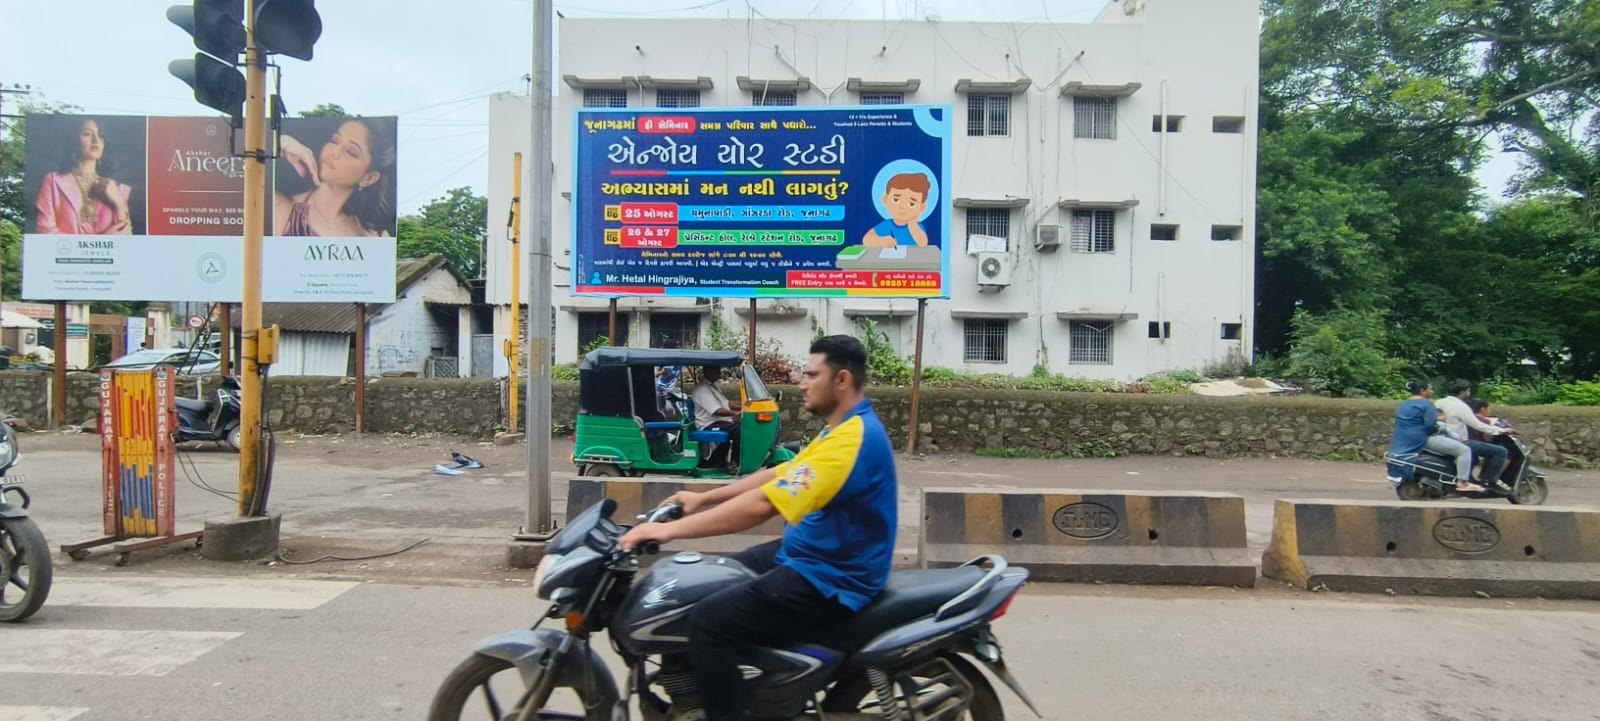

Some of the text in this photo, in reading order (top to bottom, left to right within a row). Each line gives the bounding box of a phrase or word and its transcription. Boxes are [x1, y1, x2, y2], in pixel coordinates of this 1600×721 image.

[607, 134, 845, 169] એન્જોય યોર સ્ટડી
[601, 178, 850, 201] અભ્યાસમાં મન નથી લાગતું?
[169, 216, 244, 225] DROPPING SOO
[625, 208, 641, 218] 25
[656, 228, 670, 237] 27
[77, 241, 114, 249] AKSHAR
[304, 243, 364, 261] AYRAA
[605, 274, 620, 283] Mr.
[622, 274, 646, 283] Hetal
[648, 274, 698, 285] Hingrajiya,
[101, 381, 113, 443] GUJARAT
[158, 380, 167, 441] GUJARAT
[158, 463, 167, 516] POLICE
